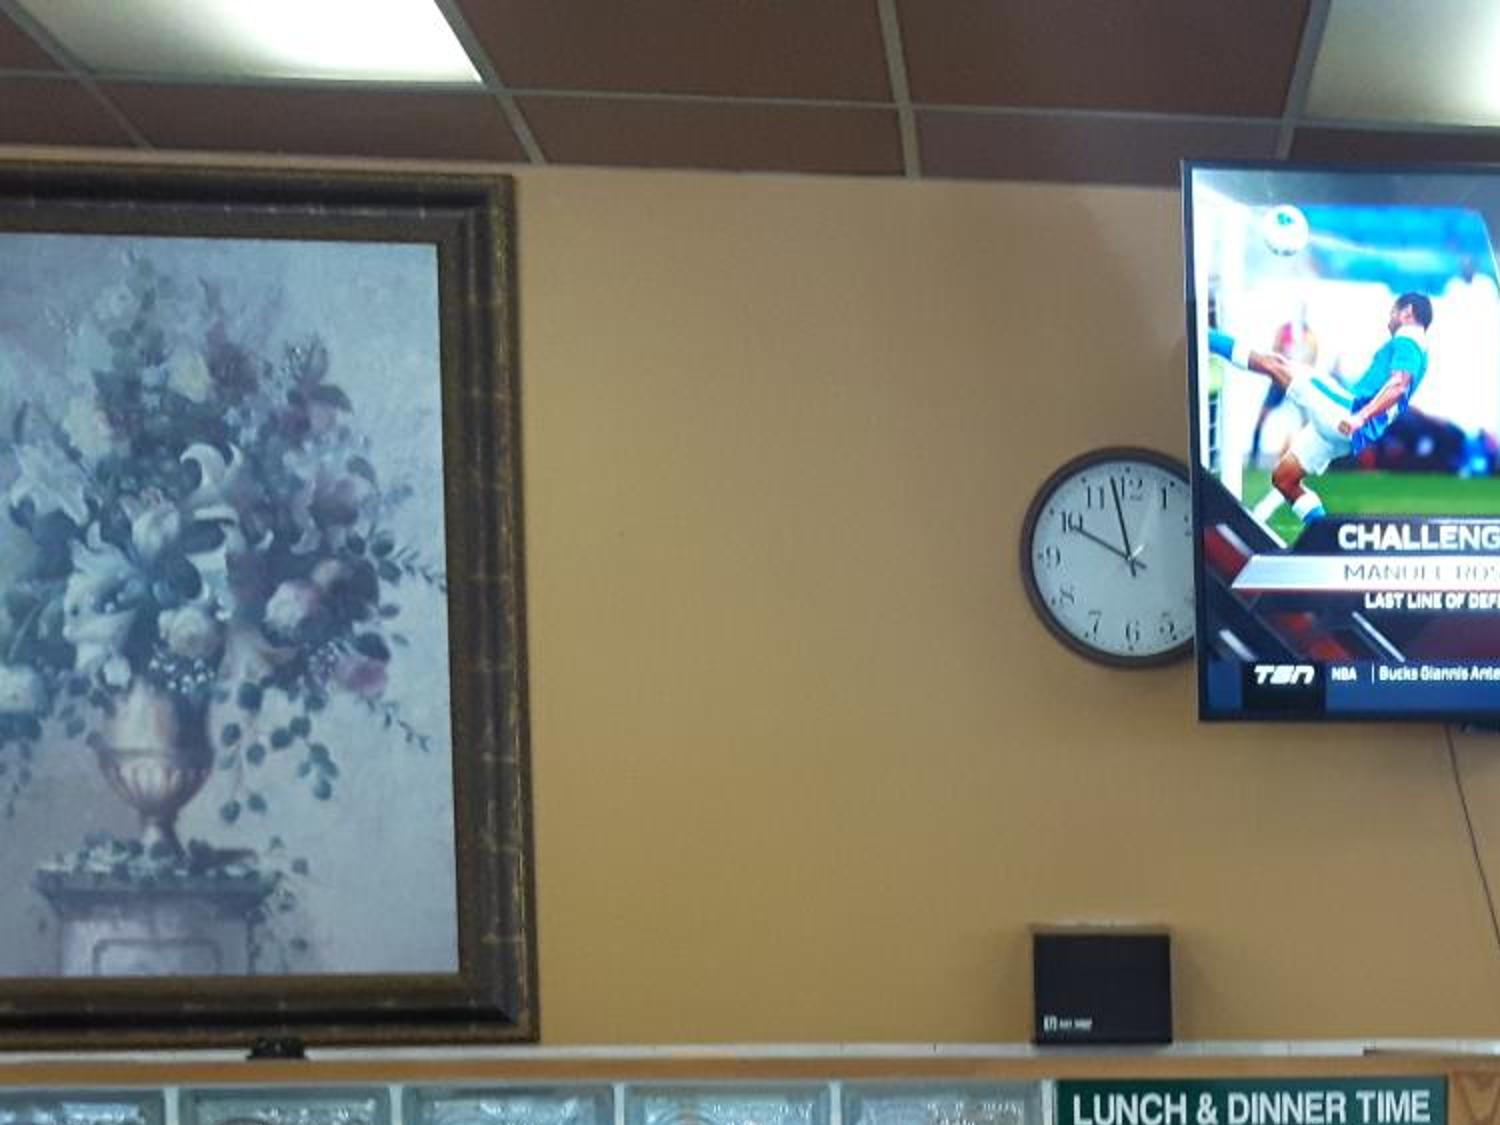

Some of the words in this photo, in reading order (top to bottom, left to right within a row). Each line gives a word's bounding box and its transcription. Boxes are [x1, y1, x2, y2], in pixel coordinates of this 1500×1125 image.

[1364, 592, 1404, 609] LAST
[1407, 592, 1442, 609] LINE
[1446, 592, 1465, 609] OF
[1254, 665, 1315, 685] TSN
[1331, 667, 1358, 681] NBA
[1379, 665, 1418, 681] Bucks
[1420, 665, 1468, 681] Giannis
[1196, 1093, 1219, 1125] &
[1227, 1092, 1347, 1125] DINNER
[1355, 1090, 1432, 1124] TIME
